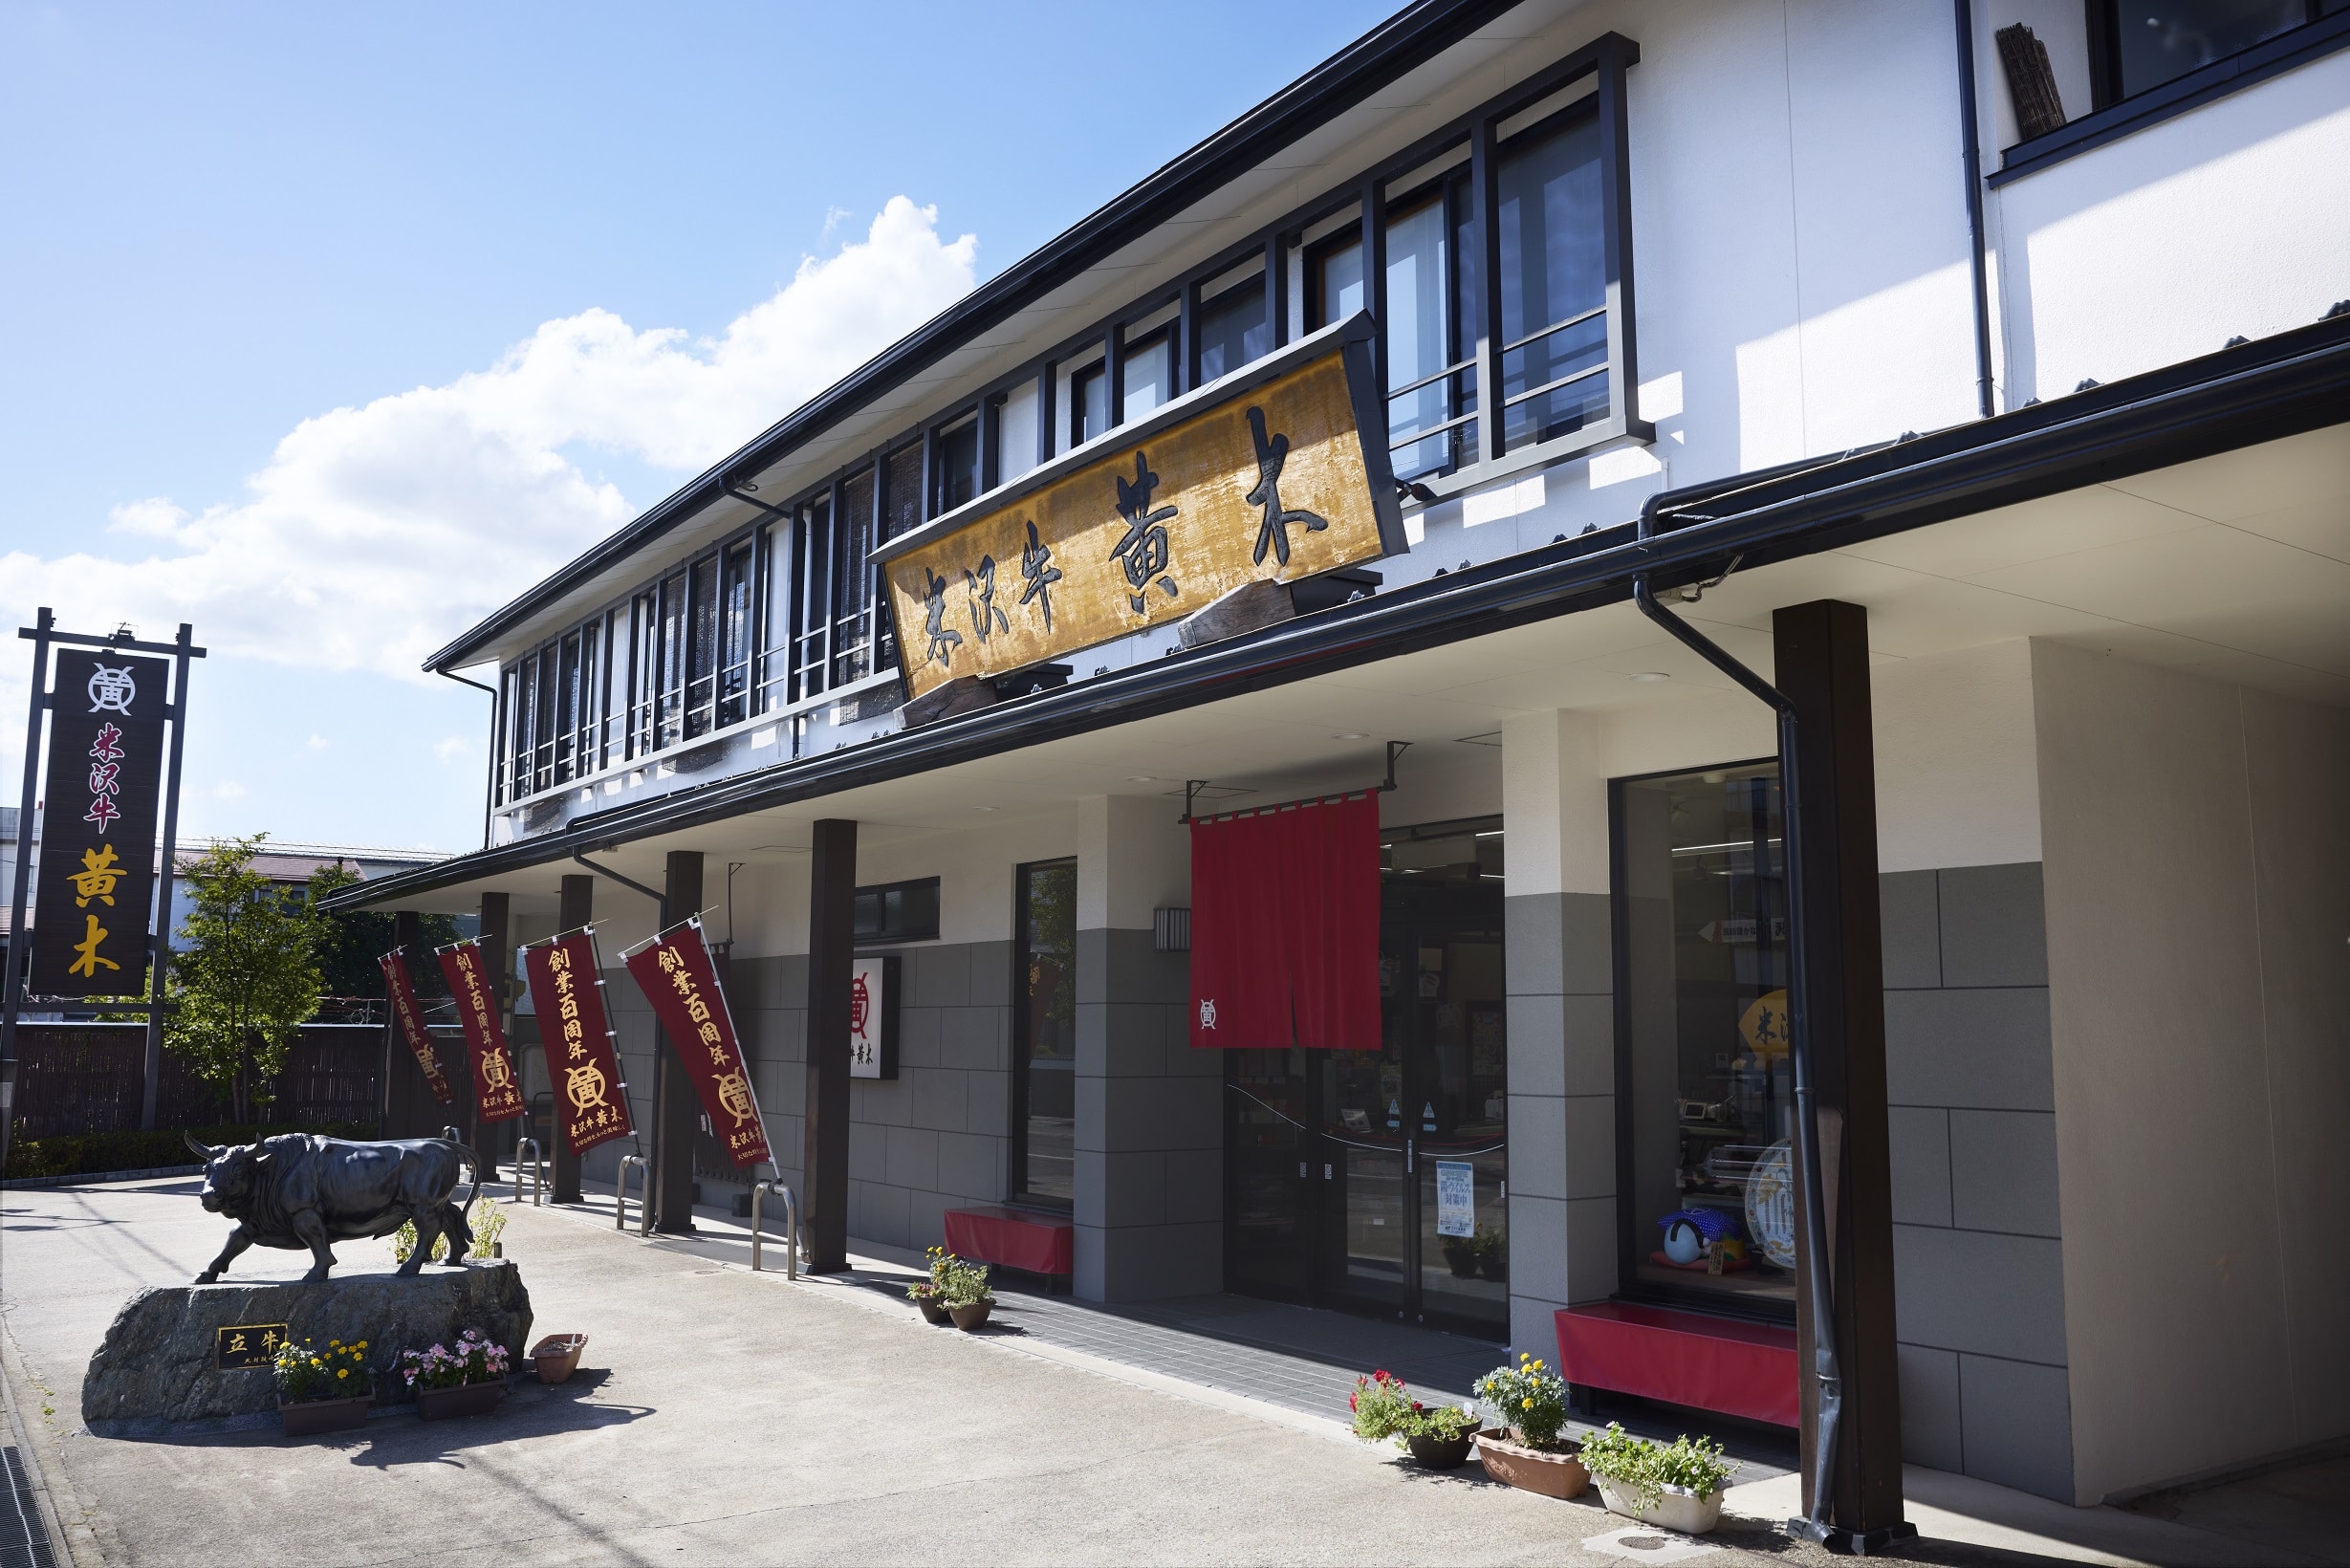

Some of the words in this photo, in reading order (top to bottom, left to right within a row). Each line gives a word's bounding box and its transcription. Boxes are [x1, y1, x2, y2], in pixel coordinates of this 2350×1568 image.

[456, 952, 493, 1047] 創業百周年
[549, 947, 588, 1060] 創業百周年
[659, 947, 730, 1067] 創業百周年
